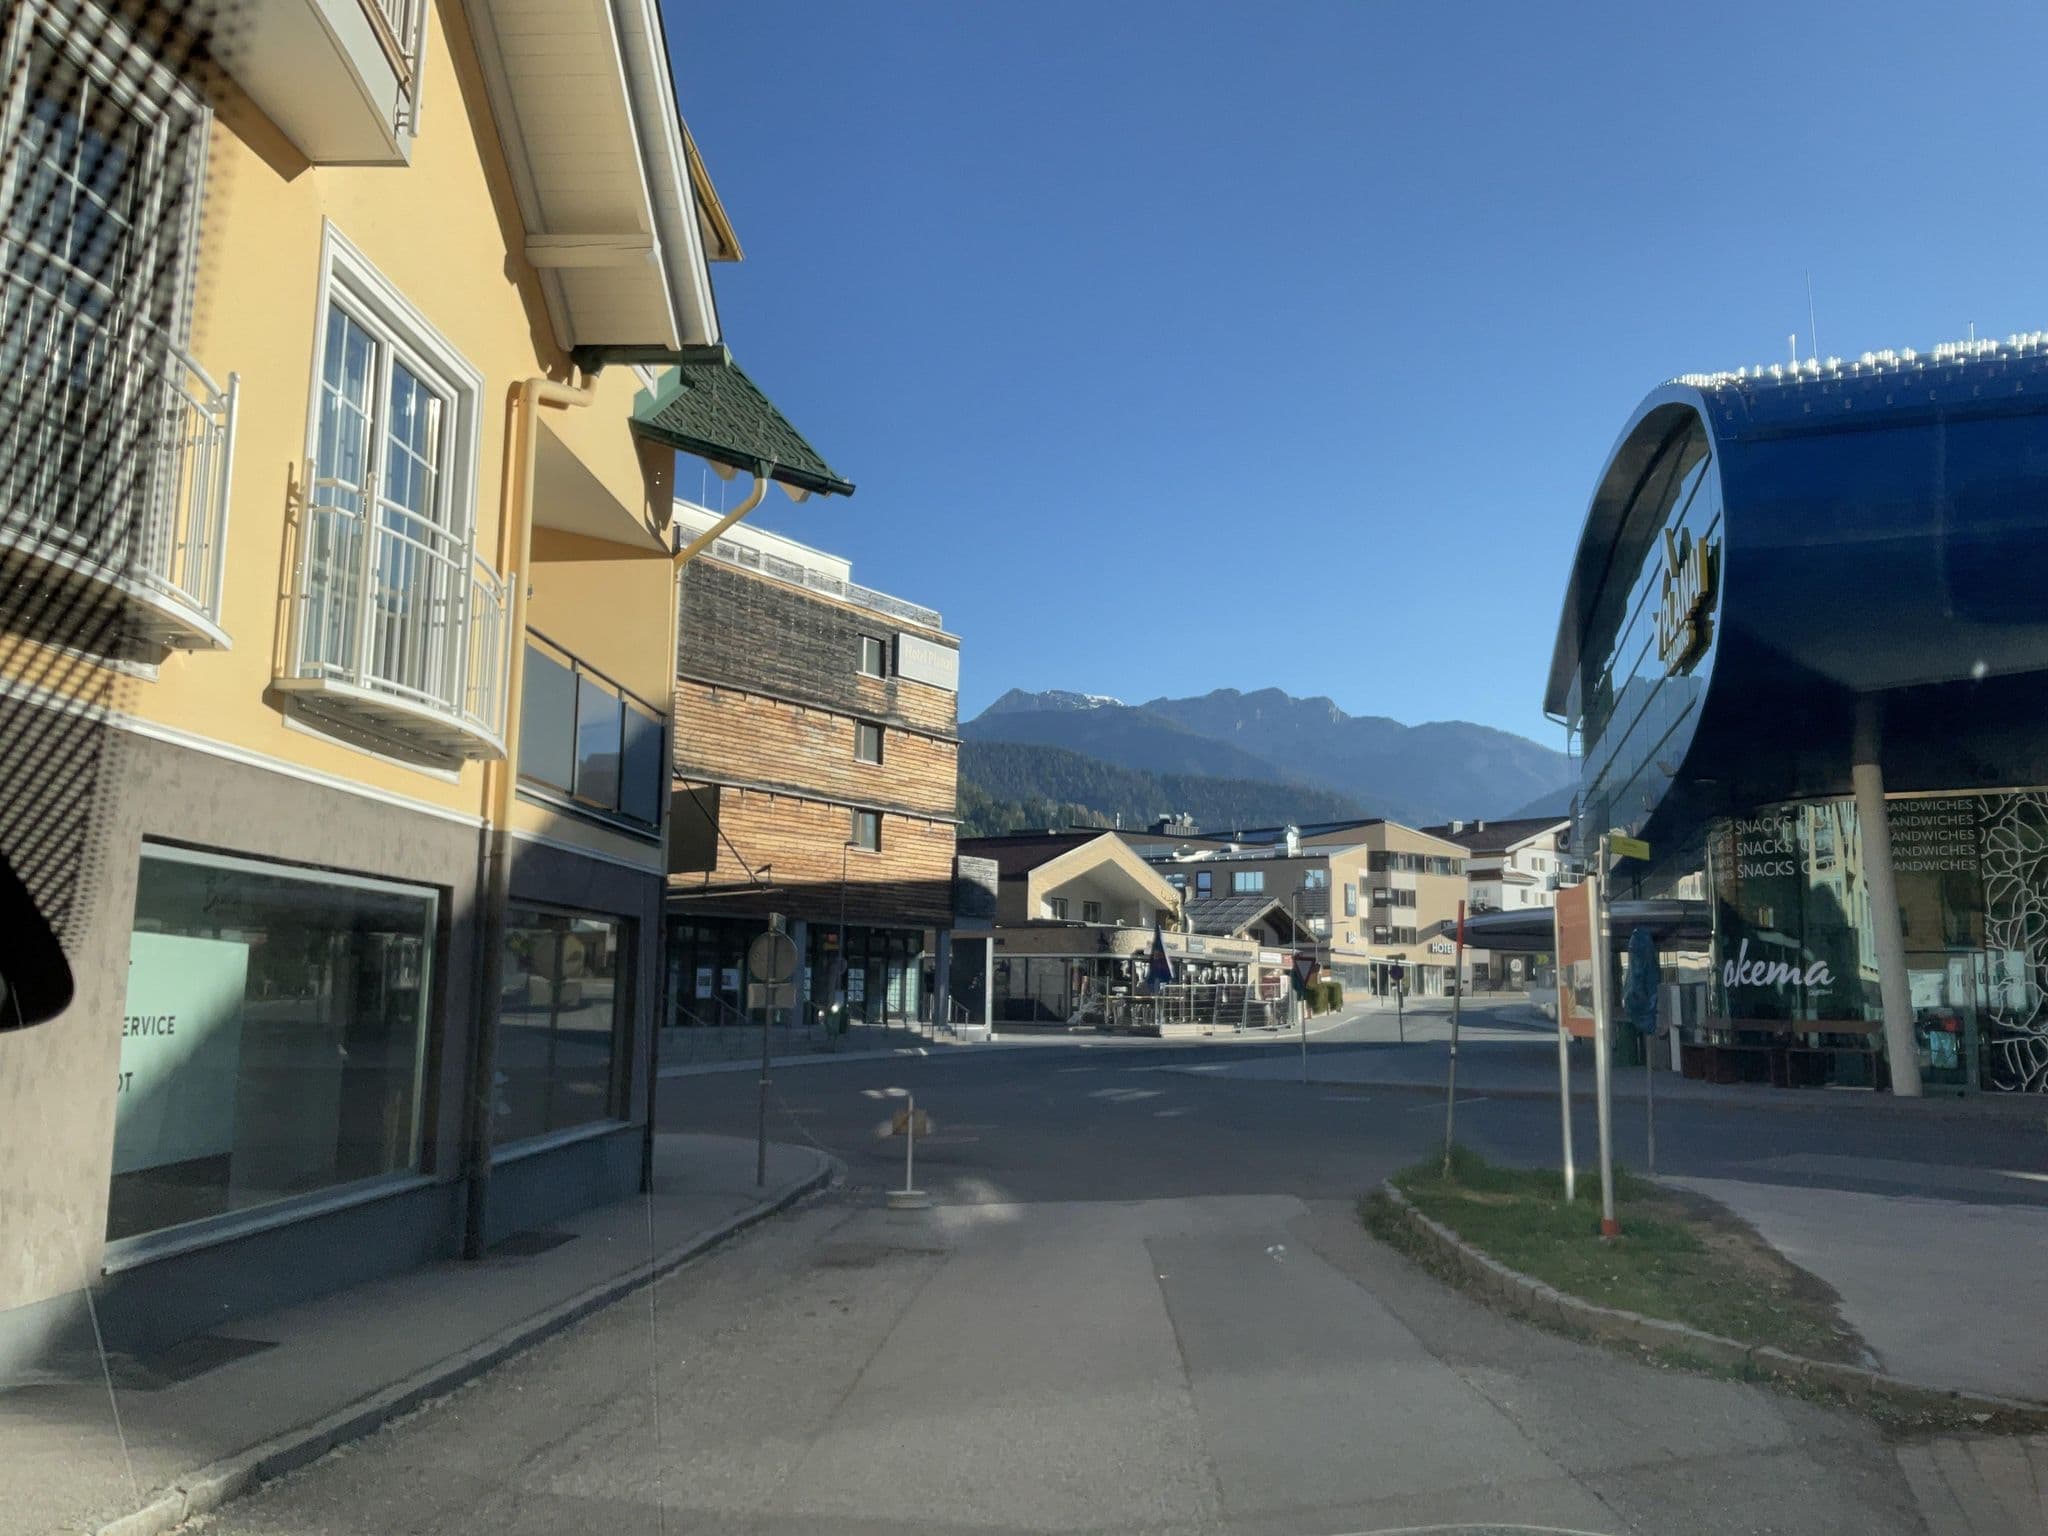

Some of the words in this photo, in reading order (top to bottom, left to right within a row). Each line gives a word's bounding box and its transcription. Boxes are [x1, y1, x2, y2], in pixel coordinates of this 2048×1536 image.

[1887, 799, 1973, 813] ANDWICHES
[1735, 816, 1792, 835] SNACKS
[1889, 814, 1974, 827] ANDWICHES
[1891, 829, 1975, 842] ANDWICHES
[1736, 838, 1793, 857] SNACKS
[1891, 844, 1976, 857] ANDWICHES
[1737, 860, 1795, 879] SNACKS
[1891, 859, 1977, 872] ANDWICHES
[1432, 942, 1455, 953] HOTEL
[1722, 938, 1836, 988] okema
[122, 1015, 176, 1037] ERVICE
